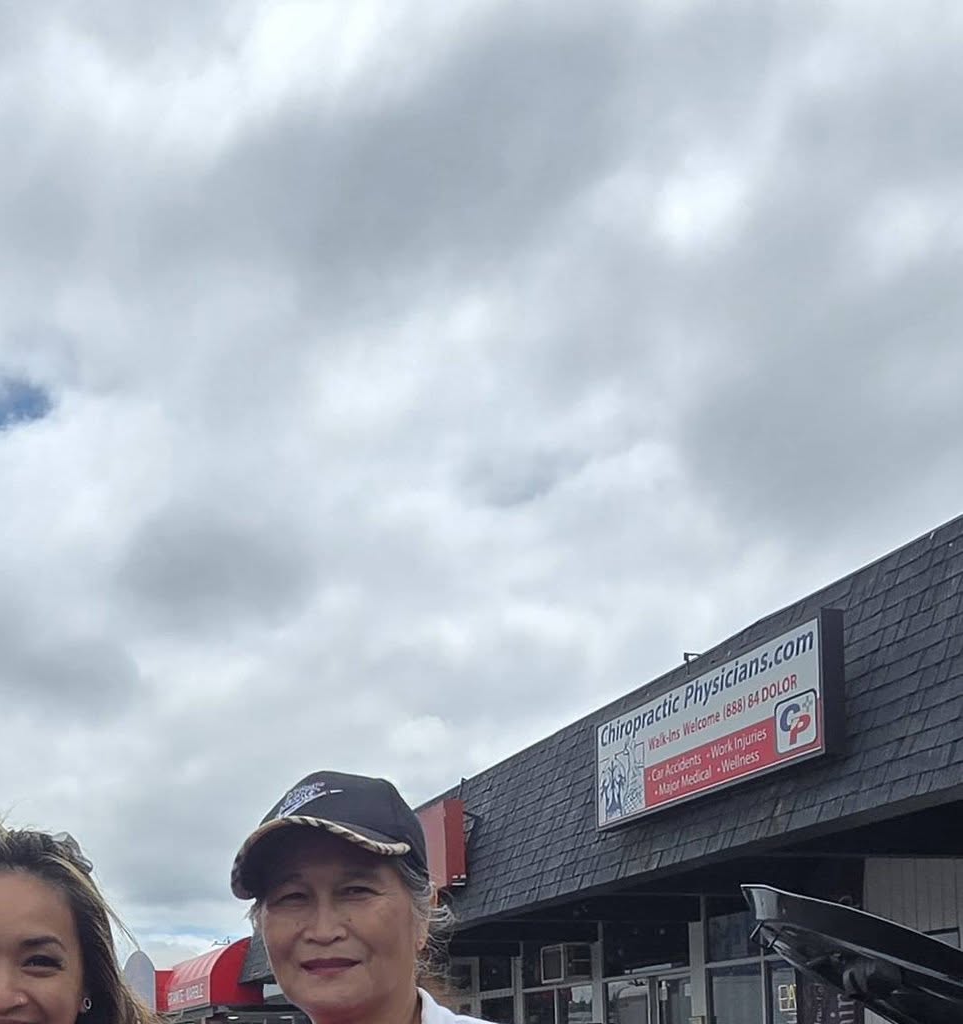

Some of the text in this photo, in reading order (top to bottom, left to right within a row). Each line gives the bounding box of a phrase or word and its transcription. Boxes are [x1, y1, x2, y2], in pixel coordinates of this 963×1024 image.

[600, 630, 814, 747] Chiropractic Physicians.com
[683, 711, 720, 737] Welcome
[723, 695, 746, 720] (888)
[748, 690, 760, 709] 84
[761, 674, 797, 703] DOLOR
[651, 727, 767, 782] Car Accidents Work Injuries
[659, 750, 759, 796] Major Medical Wellness
